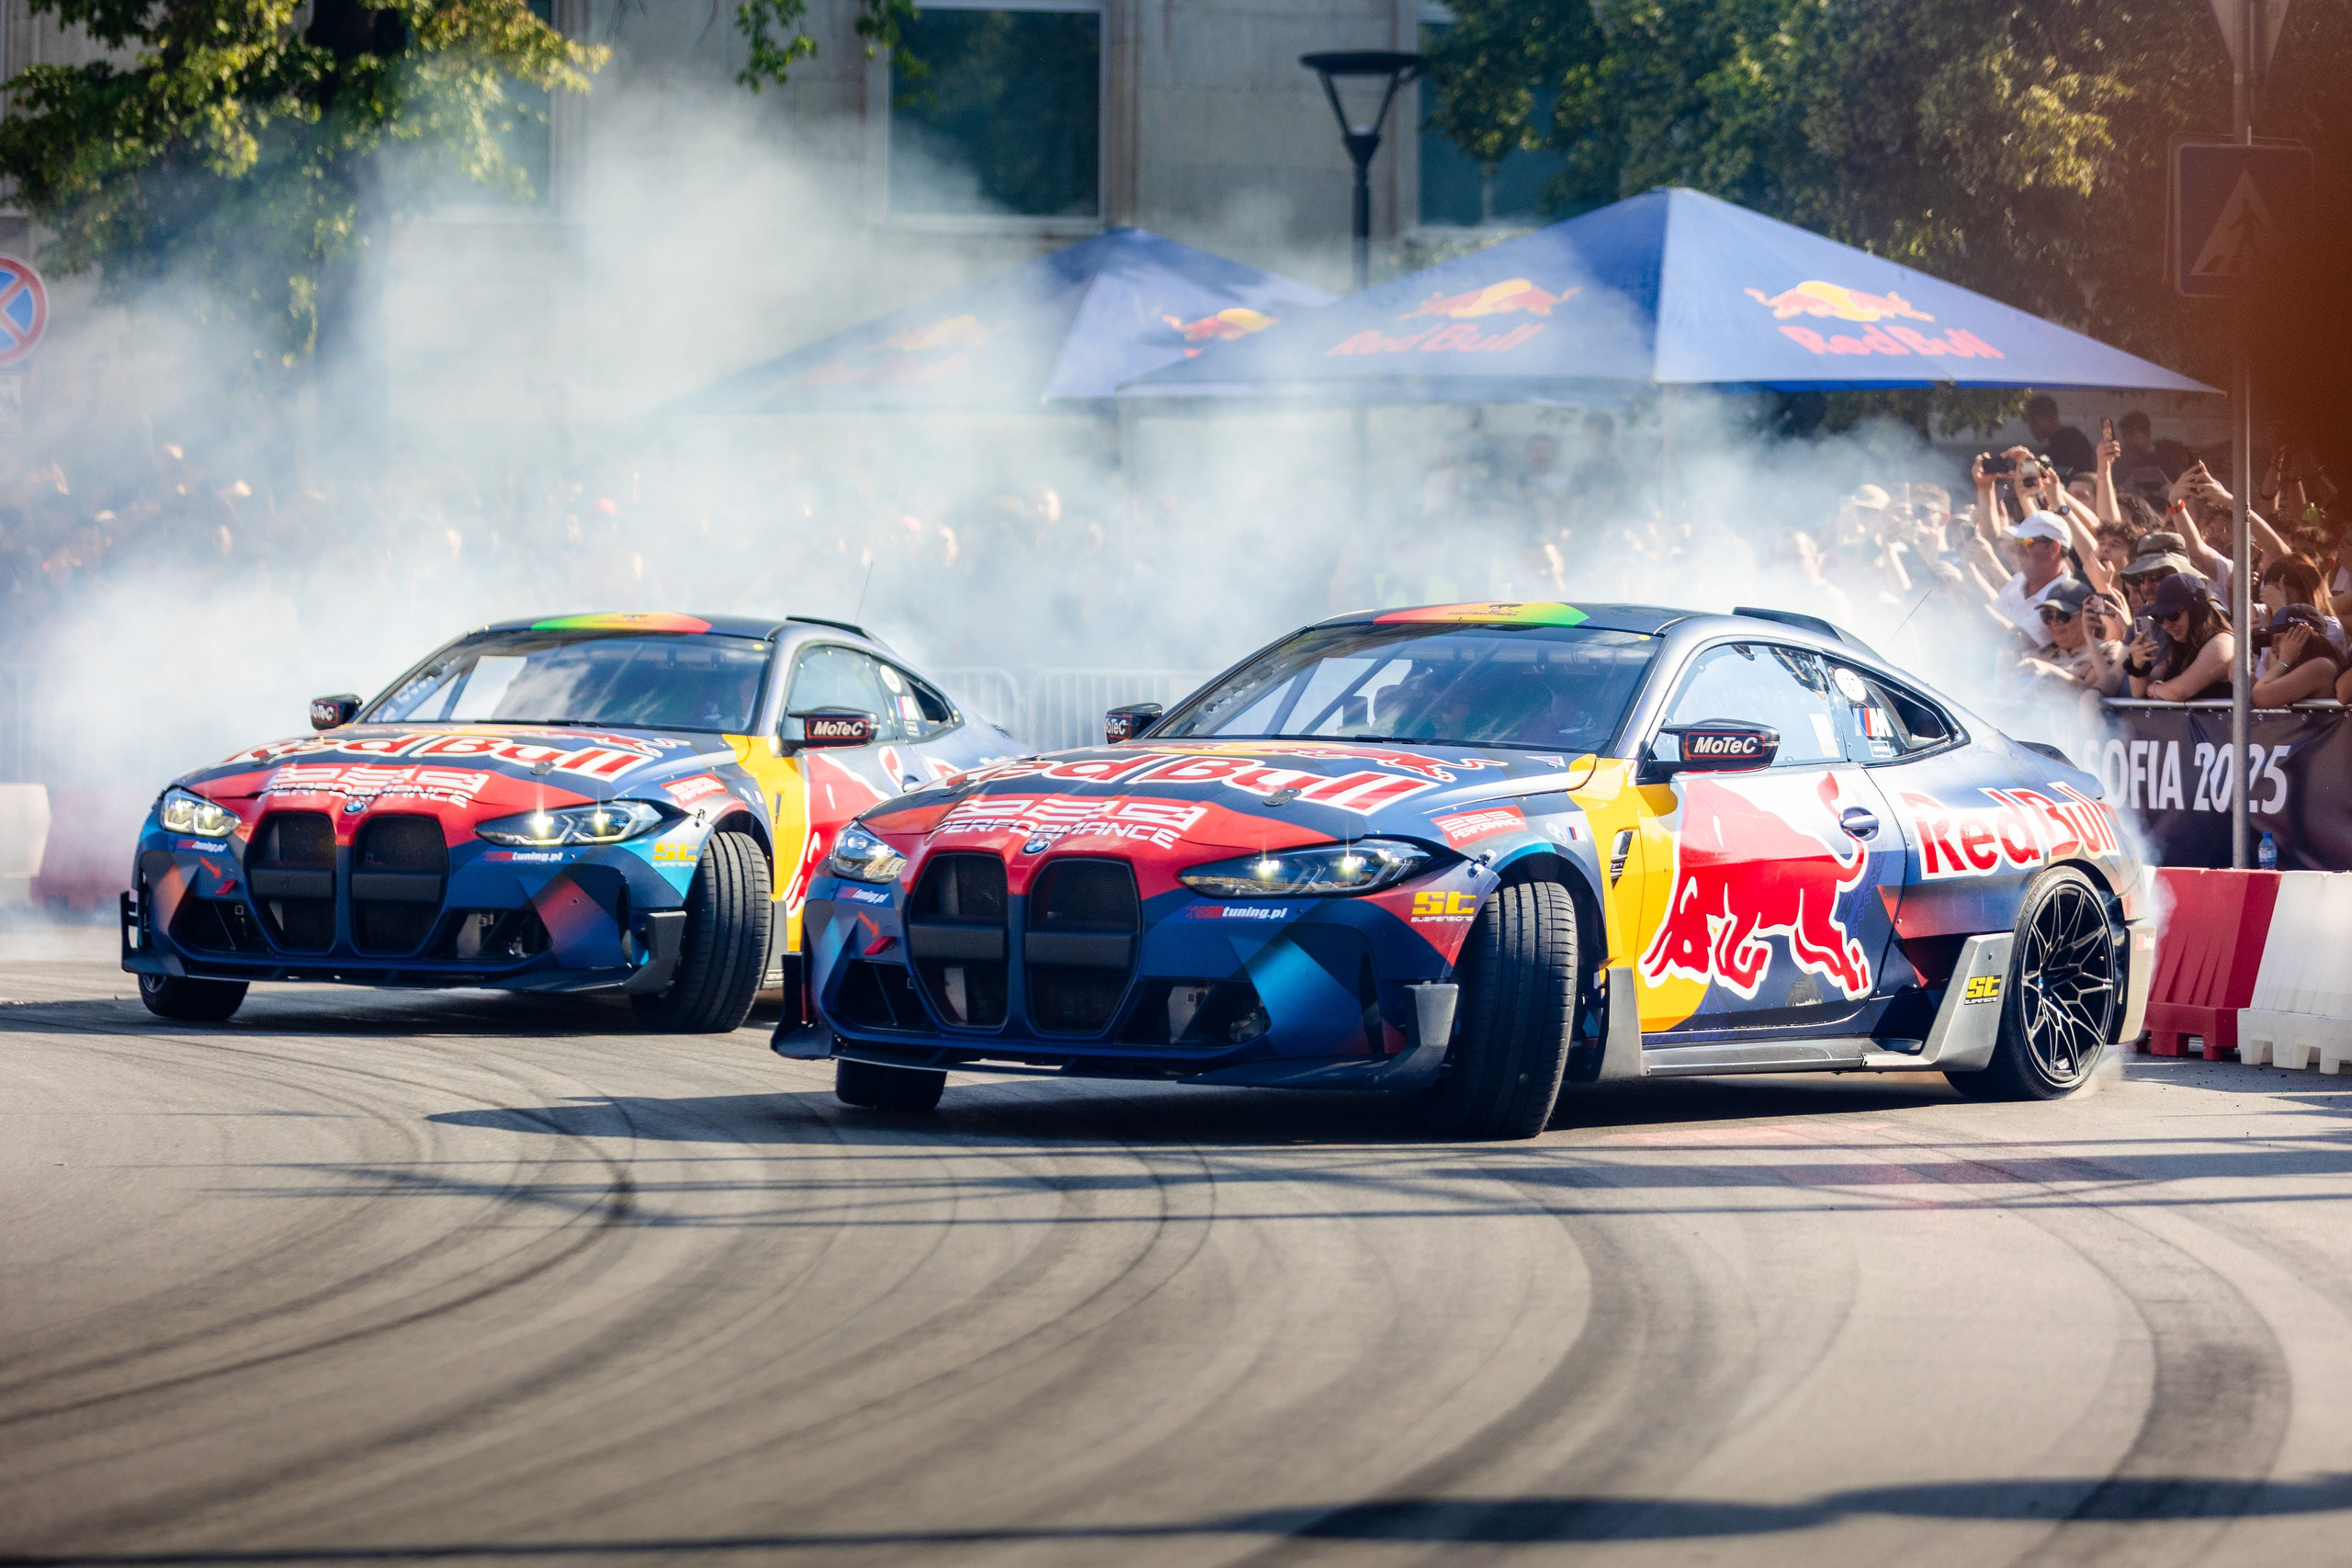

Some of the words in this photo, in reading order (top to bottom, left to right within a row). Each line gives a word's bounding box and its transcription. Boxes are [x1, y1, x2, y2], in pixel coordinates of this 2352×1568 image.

[1779, 324, 1911, 355] Red
[1885, 325, 2006, 359] Bull
[813, 721, 863, 736] MoTeC
[1693, 737, 1758, 754] MoTeC
[409, 736, 654, 783] Bull
[2082, 739, 2185, 810] SOFIA
[2193, 742, 2291, 815] 2025
[1124, 755, 1441, 816] Bull
[925, 818, 1182, 851] PERFORMANCE
[1451, 818, 1526, 840] PERFORMANCE
[1898, 787, 2043, 879] Red
[2001, 781, 2120, 862] Bull
